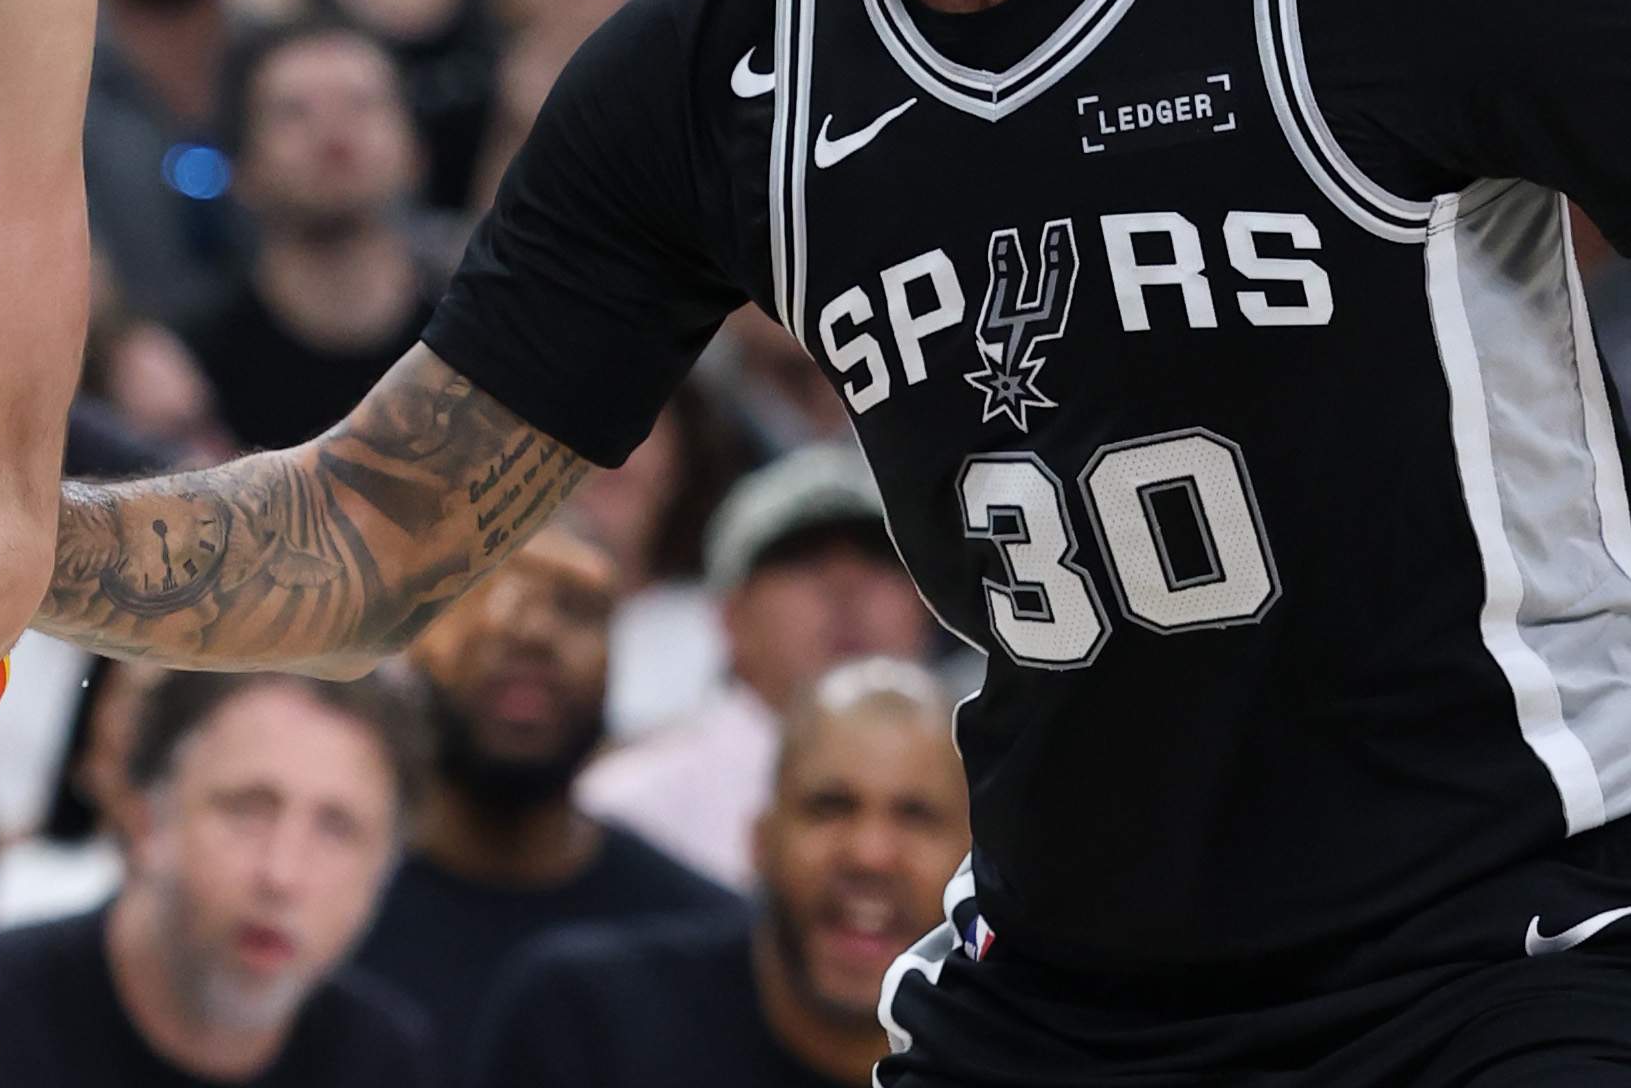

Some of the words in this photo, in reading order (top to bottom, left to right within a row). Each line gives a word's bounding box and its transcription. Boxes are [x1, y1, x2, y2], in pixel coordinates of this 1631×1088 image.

[1099, 93, 1213, 134] LEDGER
[818, 210, 1335, 432] SPURS
[955, 426, 1283, 672] 30
